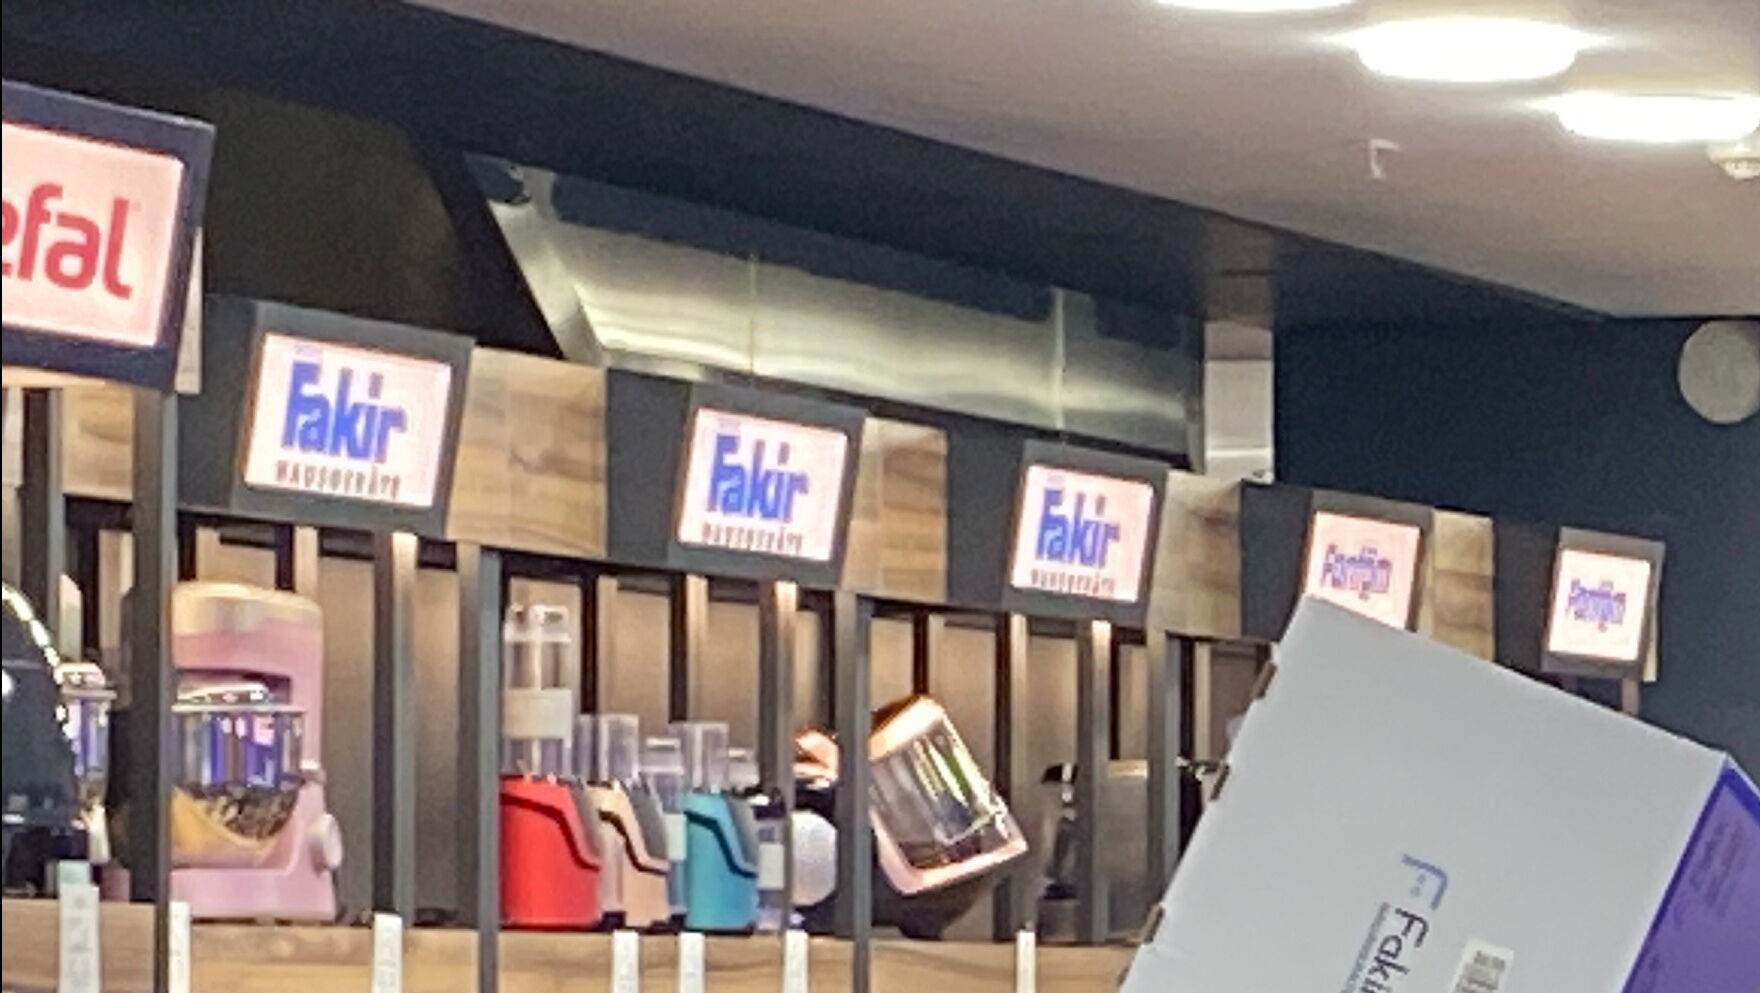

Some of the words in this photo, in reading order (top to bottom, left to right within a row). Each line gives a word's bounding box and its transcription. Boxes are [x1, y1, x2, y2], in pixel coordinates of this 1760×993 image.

[281, 361, 408, 464] Fakir
[706, 433, 811, 524] Fakir
[1035, 488, 1121, 570] Fakir
